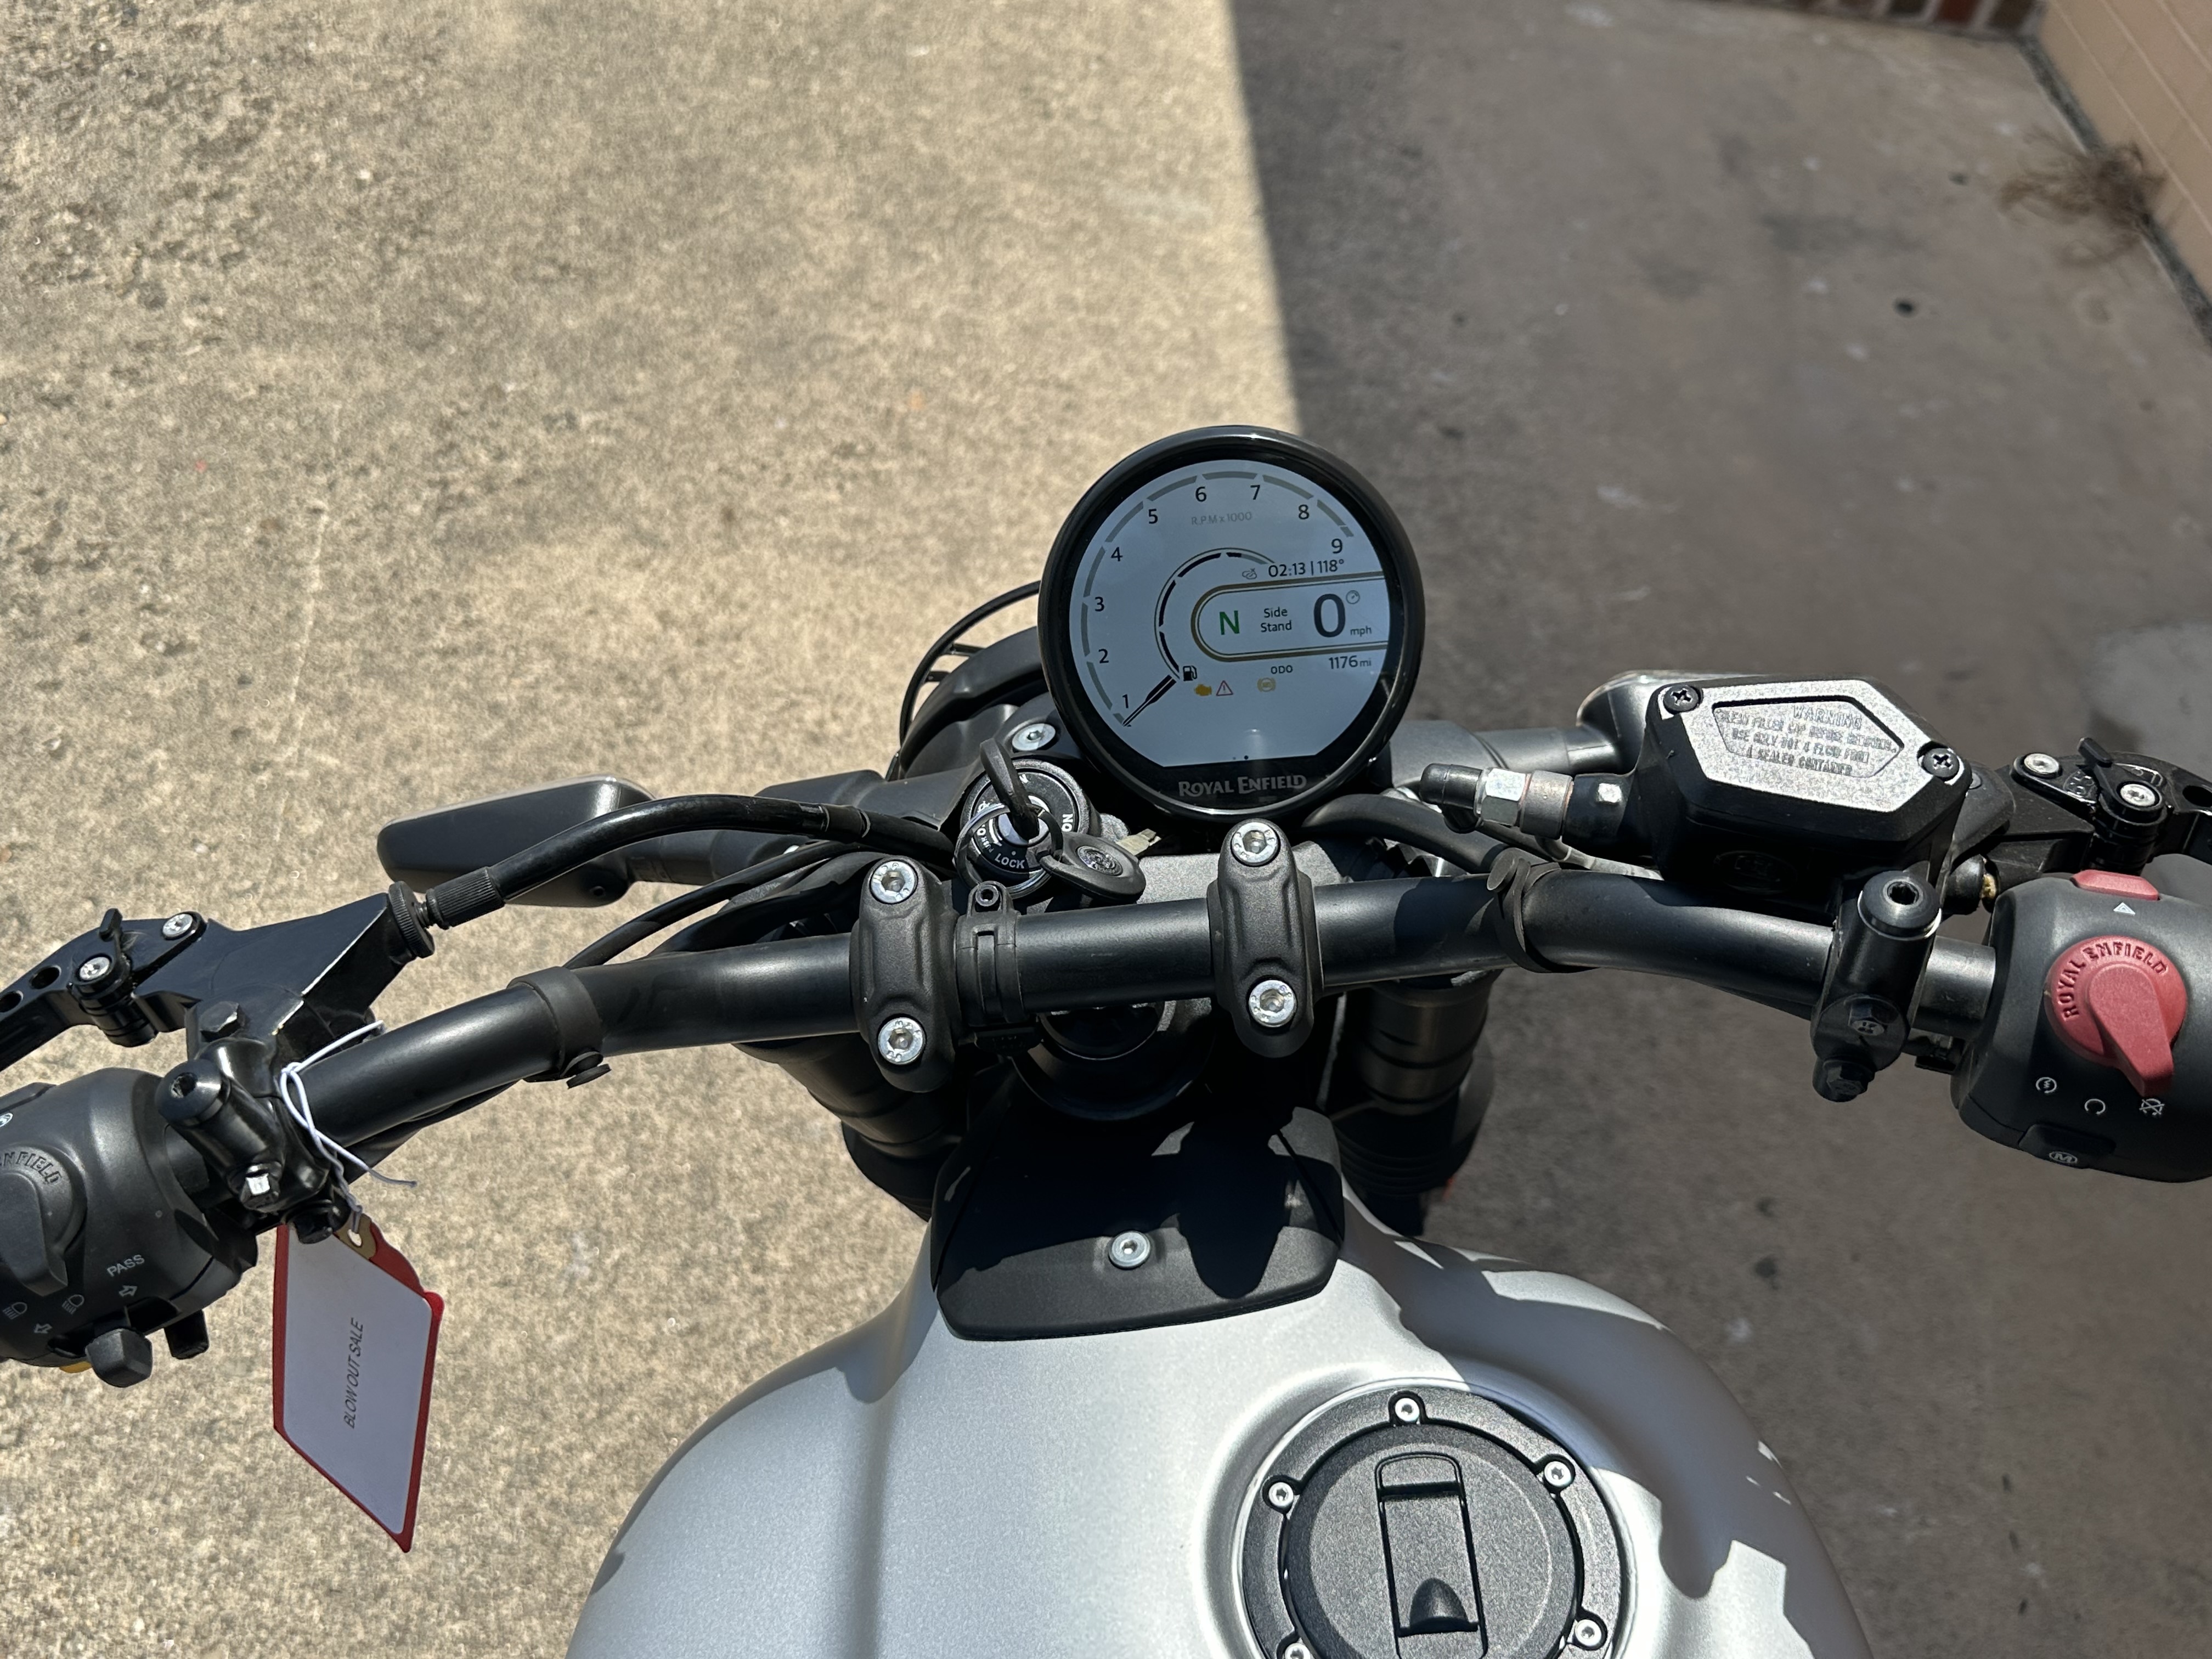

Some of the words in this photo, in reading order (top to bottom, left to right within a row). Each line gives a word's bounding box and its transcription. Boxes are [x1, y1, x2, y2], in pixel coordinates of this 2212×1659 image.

[1195, 487, 1207, 502] 6
[1250, 485, 1261, 500] 7
[1148, 509, 1158, 524] 5
[1298, 505, 1310, 520] 8
[1110, 547, 1123, 561] 4
[1331, 538, 1342, 554] 9
[1268, 562, 1306, 577] 02:13
[1094, 596, 1105, 612] 3
[1263, 606, 1288, 618] Side
[1219, 610, 1240, 635] N
[1313, 593, 1346, 637] 0
[1350, 626, 1372, 637] mph
[1261, 620, 1292, 633] Stand
[1098, 648, 1109, 663] 2
[1271, 665, 1293, 674] ODO
[1122, 694, 1128, 708] 1
[1793, 706, 1863, 729] WARNING
[1178, 780, 1234, 797] ROYAL
[1238, 775, 1307, 794] ENFIELD
[1062, 814, 1074, 832] ON
[994, 853, 1026, 869] LOCK
[2057, 960, 2086, 1021] ROYAL
[2081, 941, 2169, 975] ENFIELD
[0, 1151, 63, 1184] NFIELD
[106, 1254, 145, 1277] PASS
[349, 1317, 363, 1357] SALE
[347, 1354, 360, 1387] OUT
[344, 1385, 357, 1429] BLOW
